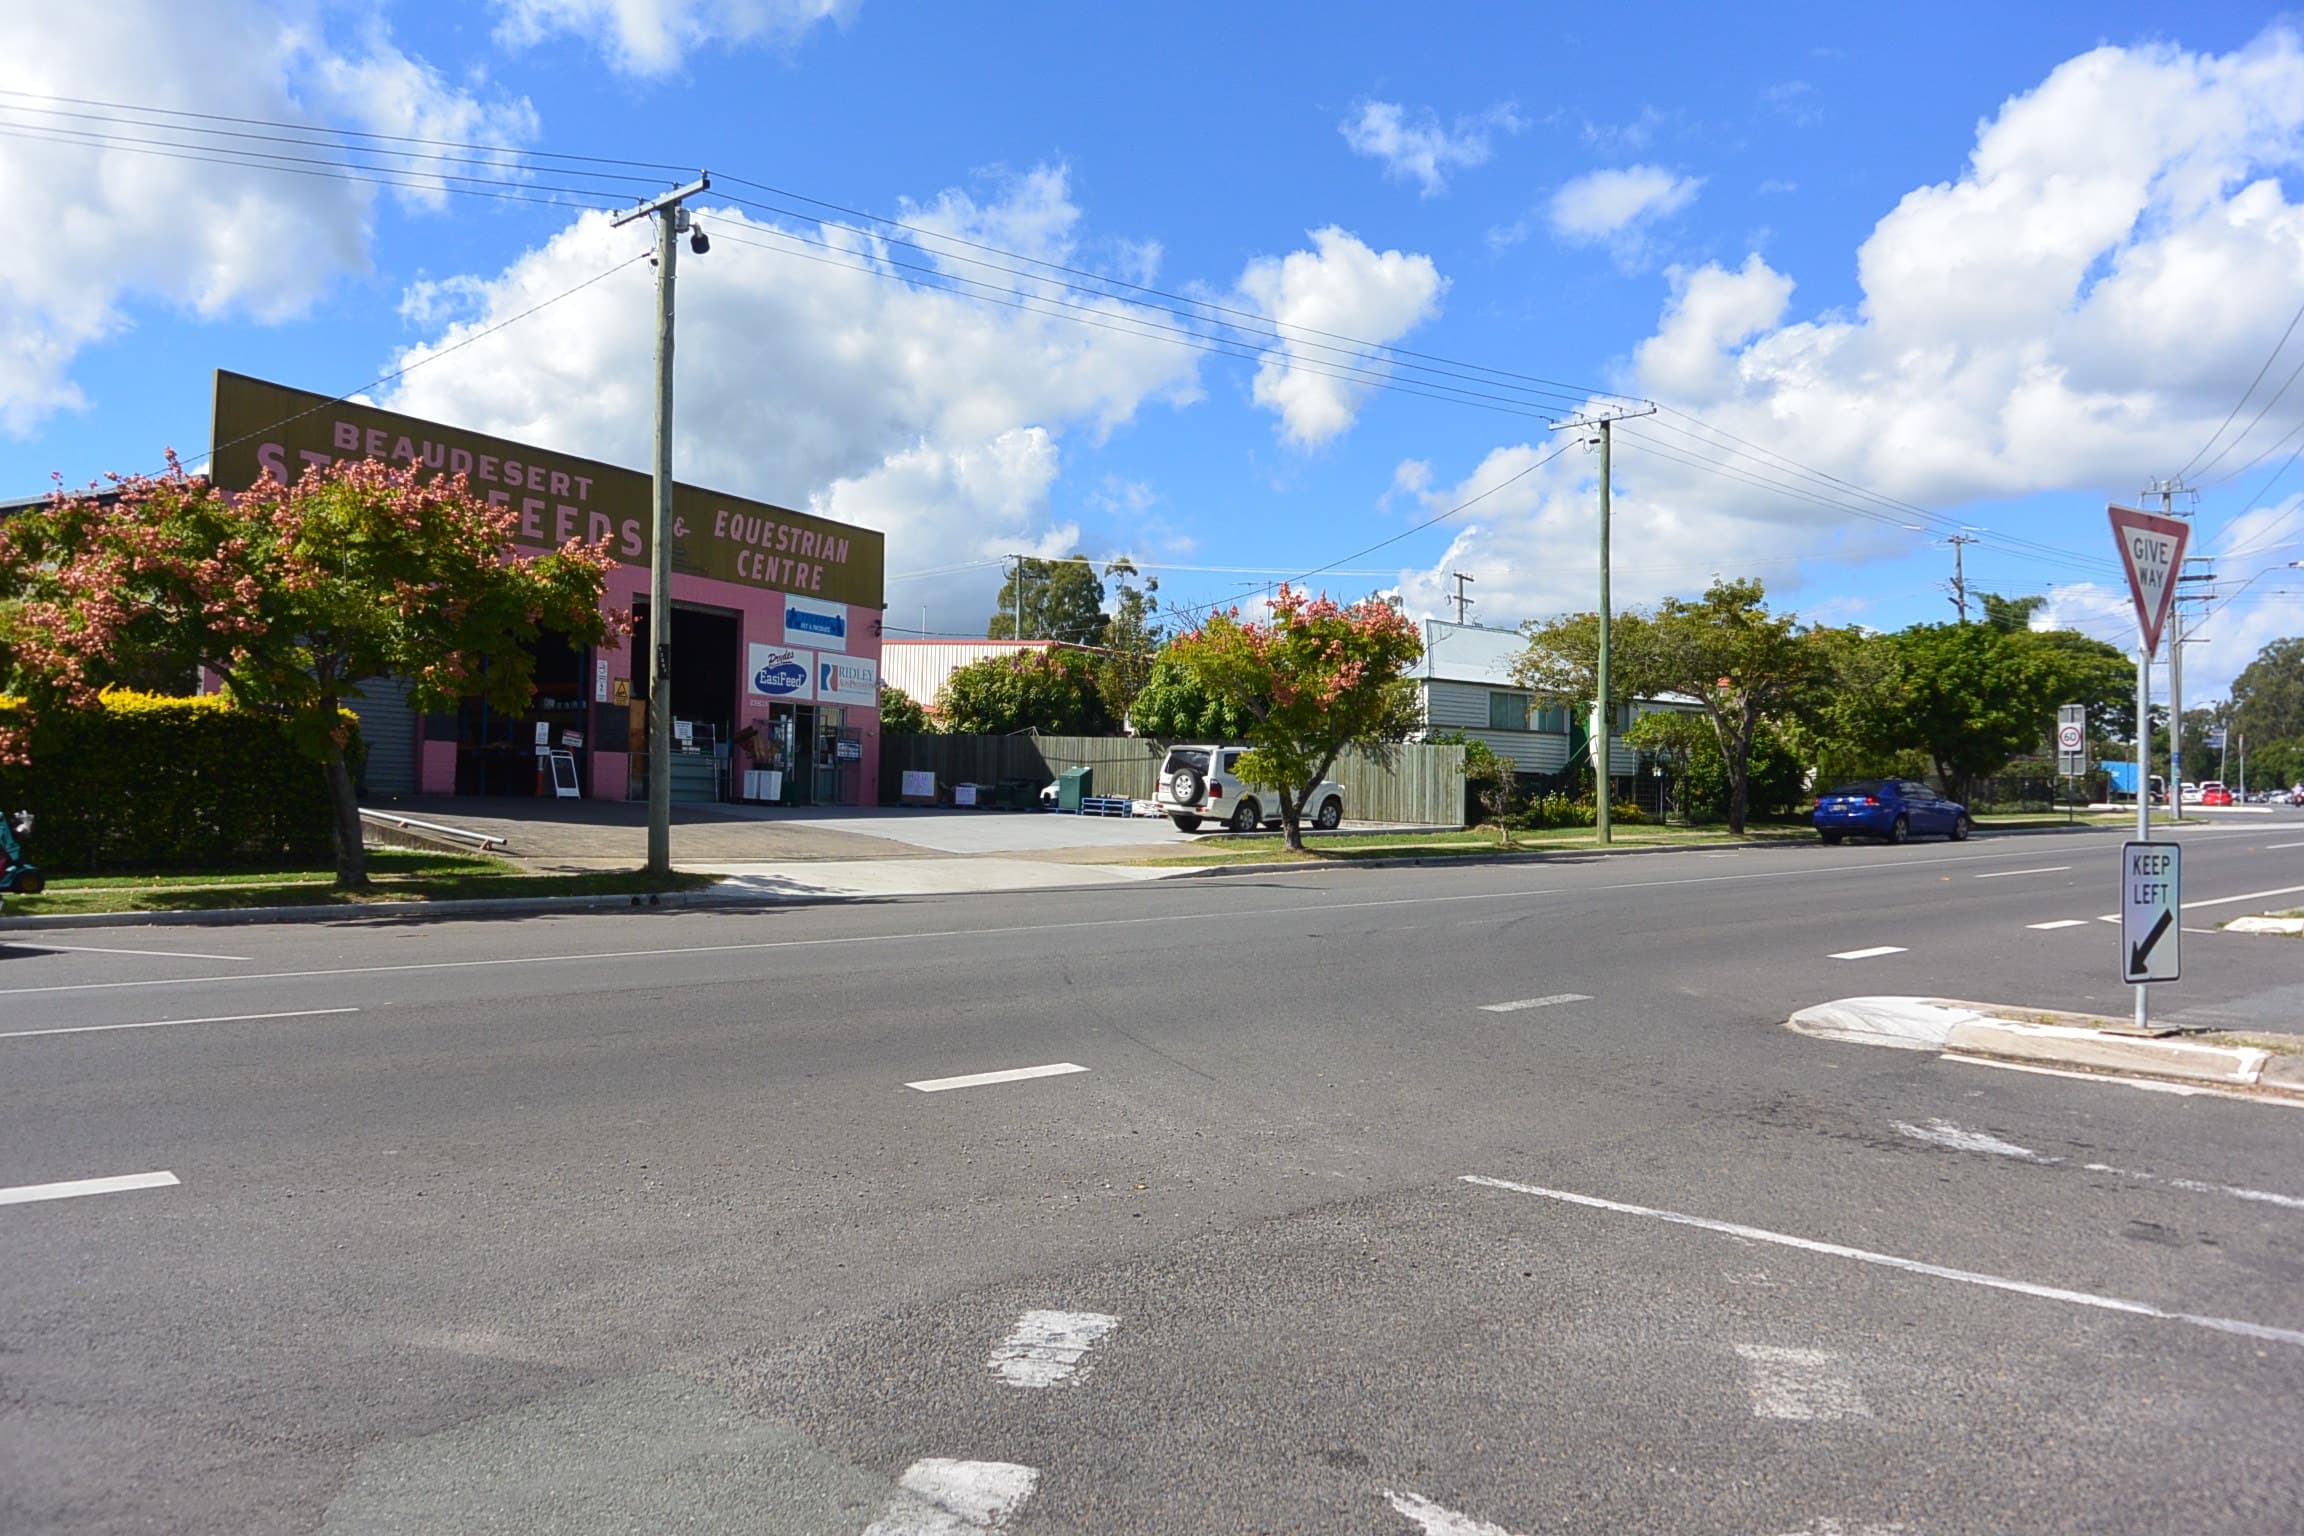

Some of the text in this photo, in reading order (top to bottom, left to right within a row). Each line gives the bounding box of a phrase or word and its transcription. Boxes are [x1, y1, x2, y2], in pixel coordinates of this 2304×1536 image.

[334, 421, 593, 500] BEAUDESERT
[673, 516, 691, 537] &
[714, 510, 849, 563] EQUESTRIAN
[2133, 537, 2169, 565] GIVE
[737, 550, 823, 590] CENTRE
[2139, 567, 2164, 588] WAY
[760, 669, 802, 688] EasiFeed
[839, 666, 874, 682] RIDLEY
[2064, 732, 2077, 742] 60
[2133, 855, 2171, 876] KEEP
[2134, 884, 2168, 904] LEFT
